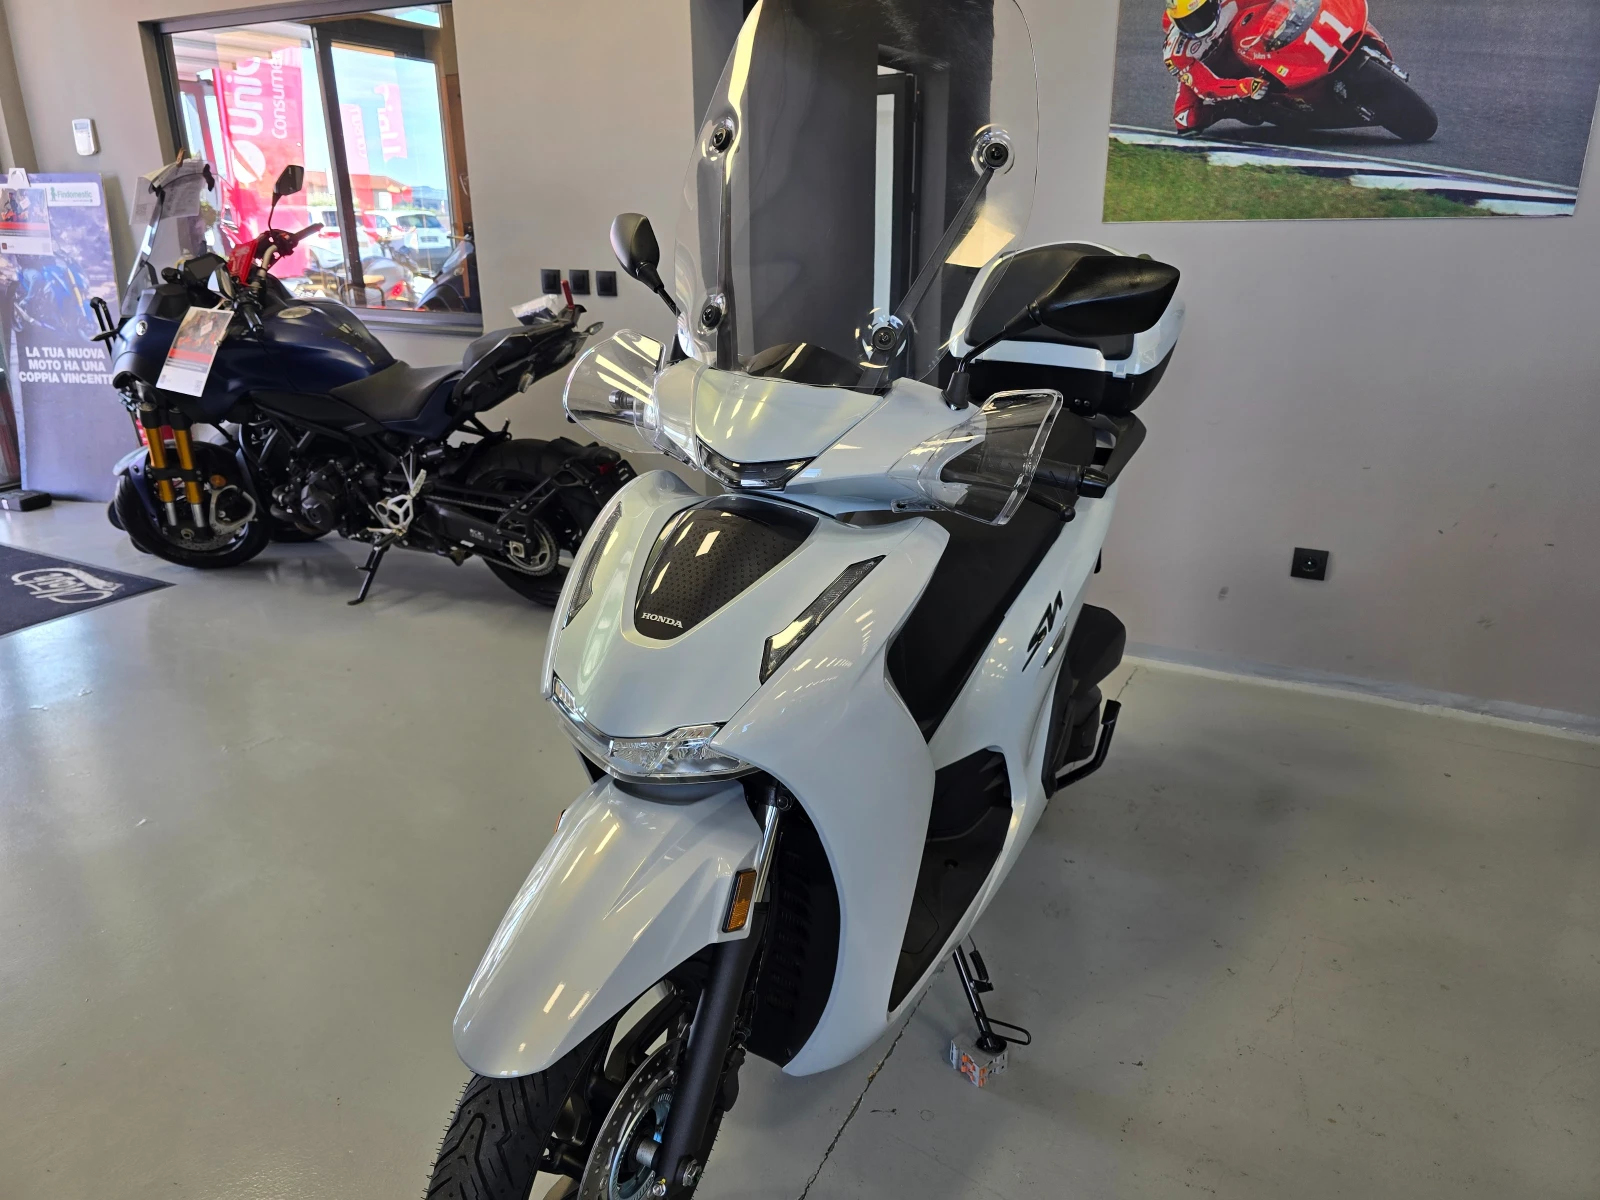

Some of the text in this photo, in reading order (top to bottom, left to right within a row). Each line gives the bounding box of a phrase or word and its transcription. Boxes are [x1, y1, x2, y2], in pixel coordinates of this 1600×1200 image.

[1304, 10, 1353, 64] 11
[271, 51, 288, 139] Consume
[57, 190, 93, 199] Findomestic
[25, 346, 106, 360] LA TUA NUOVA
[28, 359, 106, 373] MOTO HA UNA
[19, 371, 60, 384] COPPIA
[641, 612, 684, 629] HONDA
